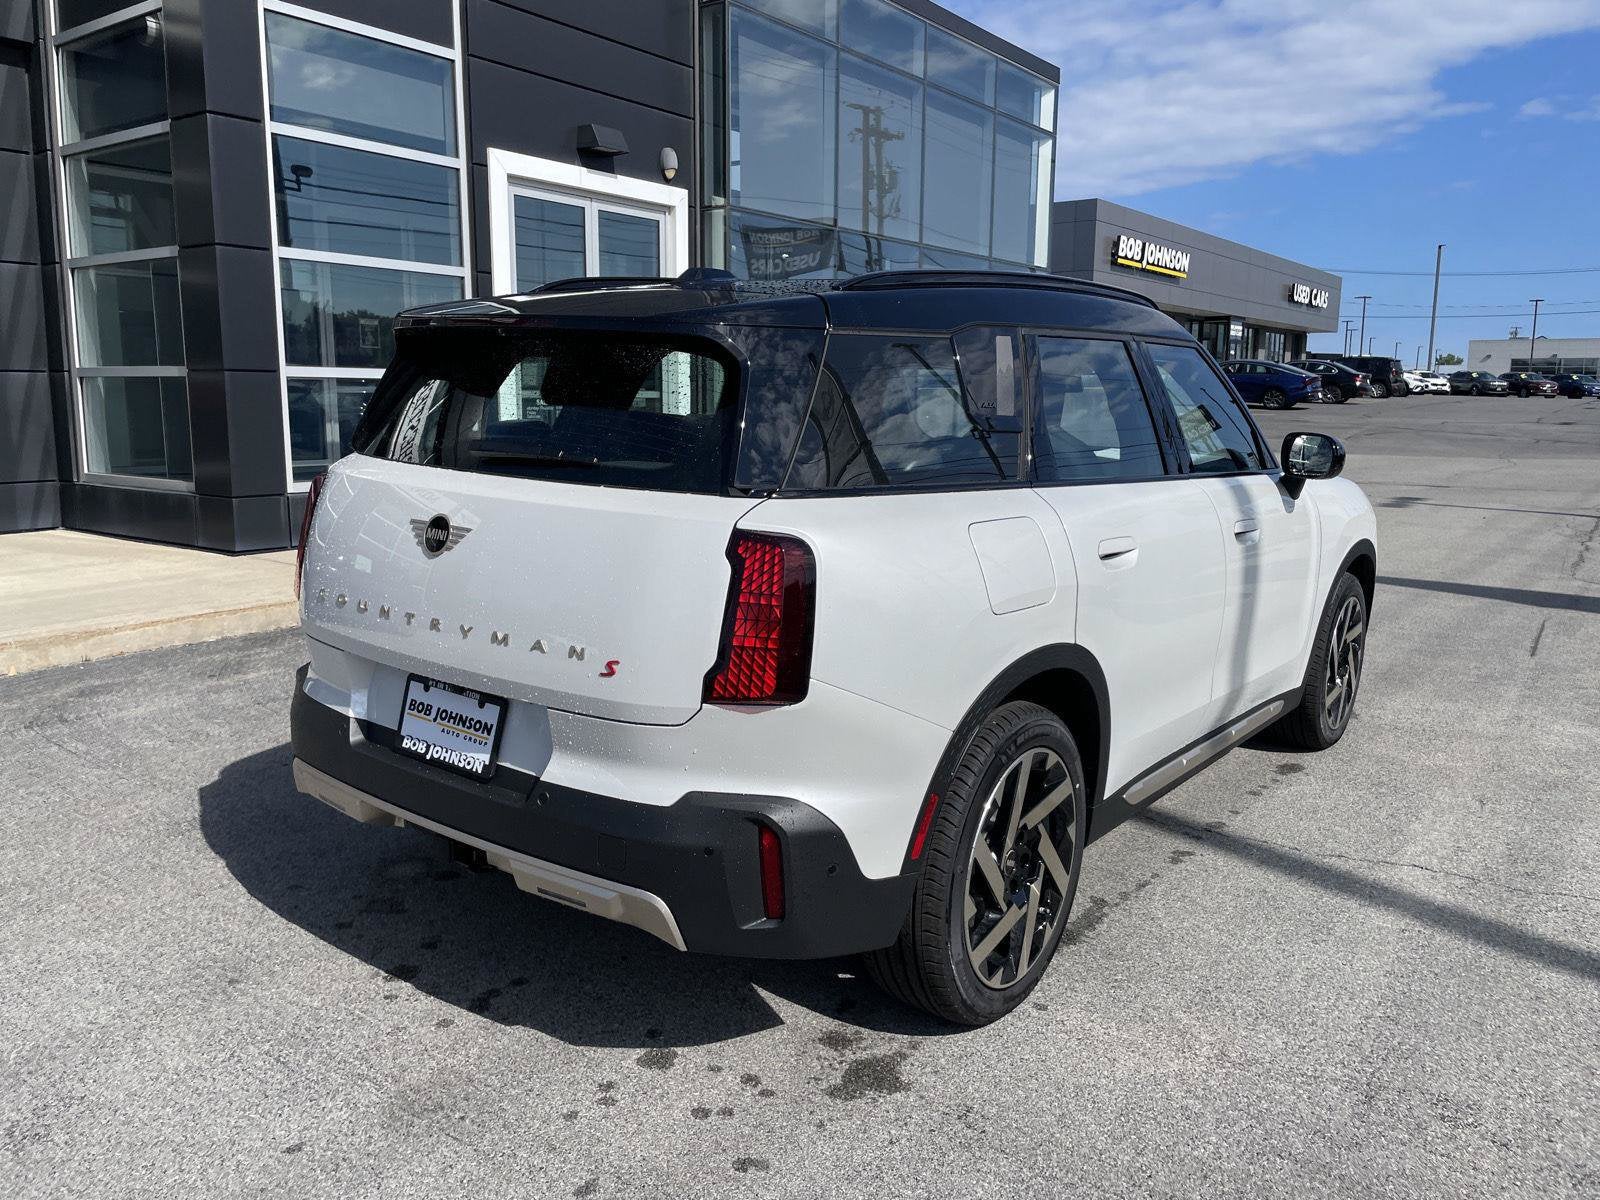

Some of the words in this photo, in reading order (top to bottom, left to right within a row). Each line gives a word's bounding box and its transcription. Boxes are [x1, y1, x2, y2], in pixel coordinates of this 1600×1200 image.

[1118, 235, 1143, 260] BOB
[1142, 242, 1190, 272] JOHNSON
[1293, 283, 1310, 304] USED
[1311, 288, 1329, 309] CARS
[426, 527, 448, 541] MINI
[318, 587, 585, 661] COUNTRYMAN
[598, 659, 620, 678] S
[408, 698, 433, 716] BOB
[433, 707, 494, 736] JOHNSON
[402, 736, 427, 754] BOB
[426, 744, 485, 774] JOHNSON
[441, 728, 460, 738] AUTO
[463, 735, 488, 747] GROUP
